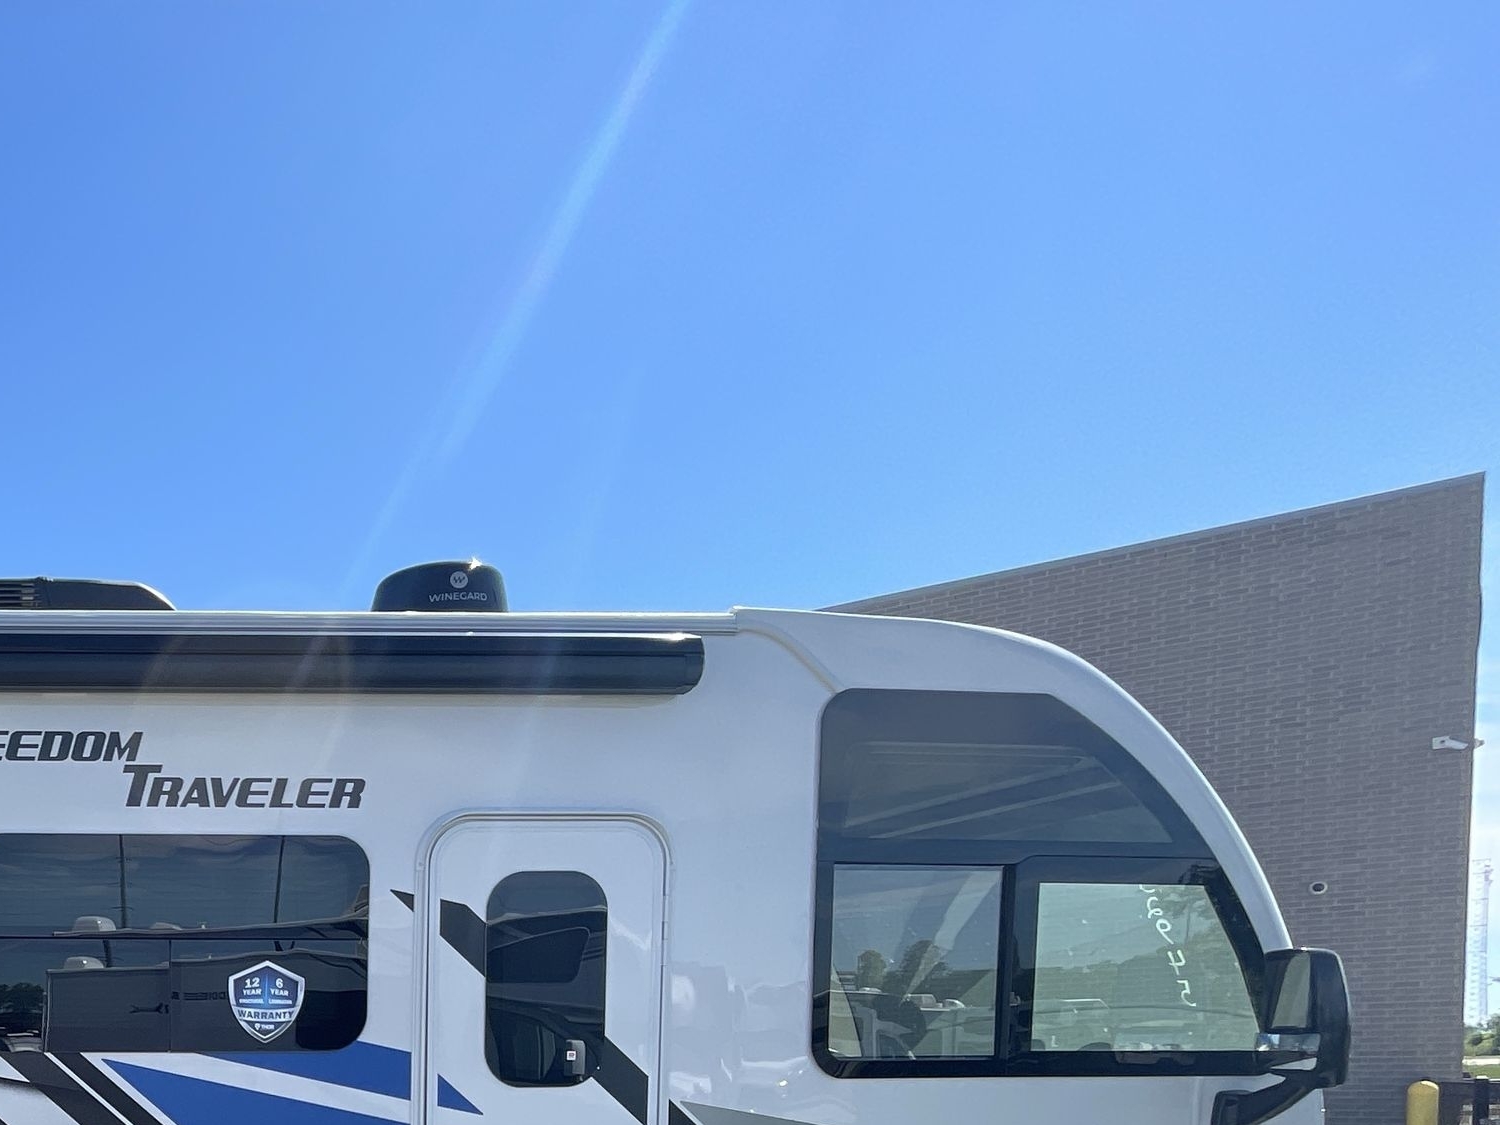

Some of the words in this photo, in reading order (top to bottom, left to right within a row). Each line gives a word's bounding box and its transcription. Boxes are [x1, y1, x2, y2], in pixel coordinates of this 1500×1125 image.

[428, 591, 488, 603] WINEGARD
[122, 764, 367, 809] TRAVELER
[244, 976, 260, 989] 12
[275, 977, 284, 989] 6
[242, 988, 262, 996] YEAR
[269, 988, 289, 997] YEAR
[237, 1009, 295, 1020] WARRANTY
